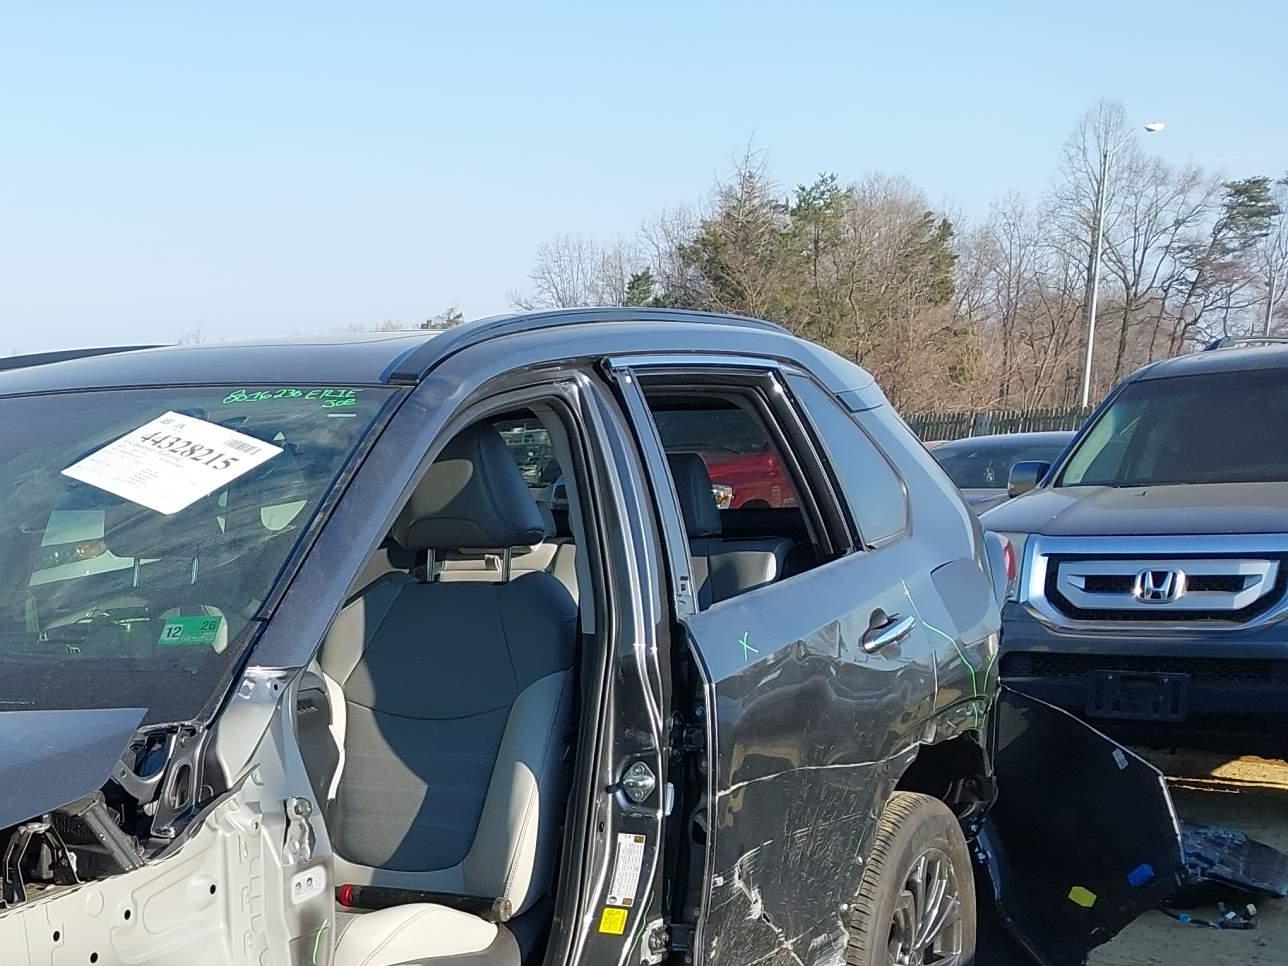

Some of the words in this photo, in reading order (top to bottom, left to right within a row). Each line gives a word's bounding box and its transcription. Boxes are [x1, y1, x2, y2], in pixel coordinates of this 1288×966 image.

[140, 431, 241, 470] 44328215
[200, 620, 217, 631] 26
[165, 626, 182, 638] 12
